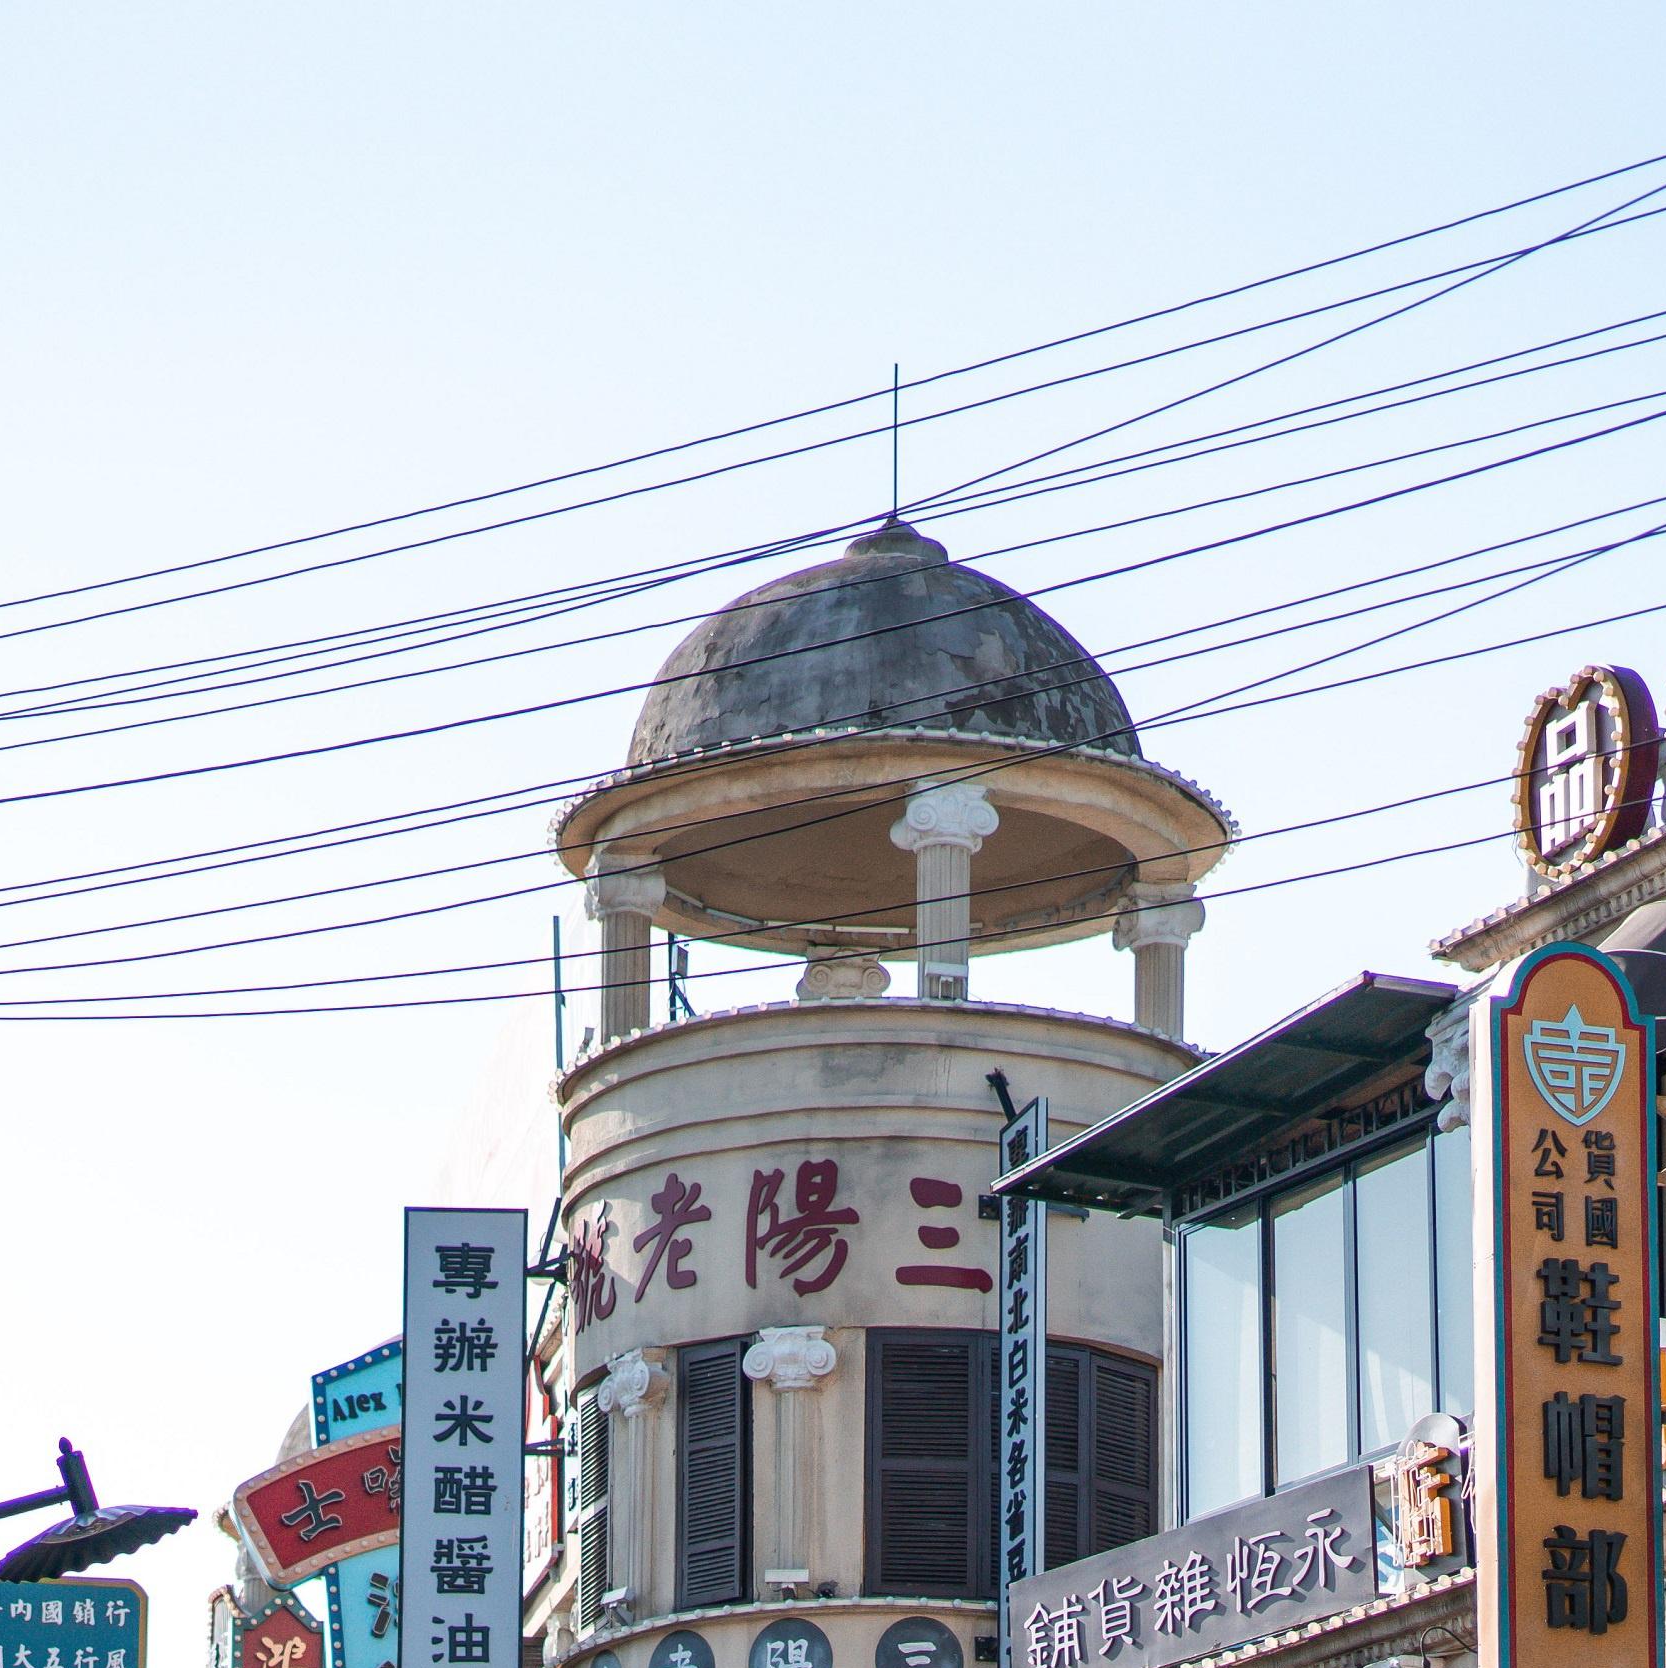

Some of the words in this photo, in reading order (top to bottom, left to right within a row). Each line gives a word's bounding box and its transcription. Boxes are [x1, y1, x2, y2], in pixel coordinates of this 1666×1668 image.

[571, 1159, 993, 1334] 三陽老號
[331, 1392, 386, 1423] Alex
[1536, 1257, 1629, 1635] 鞋帽部
